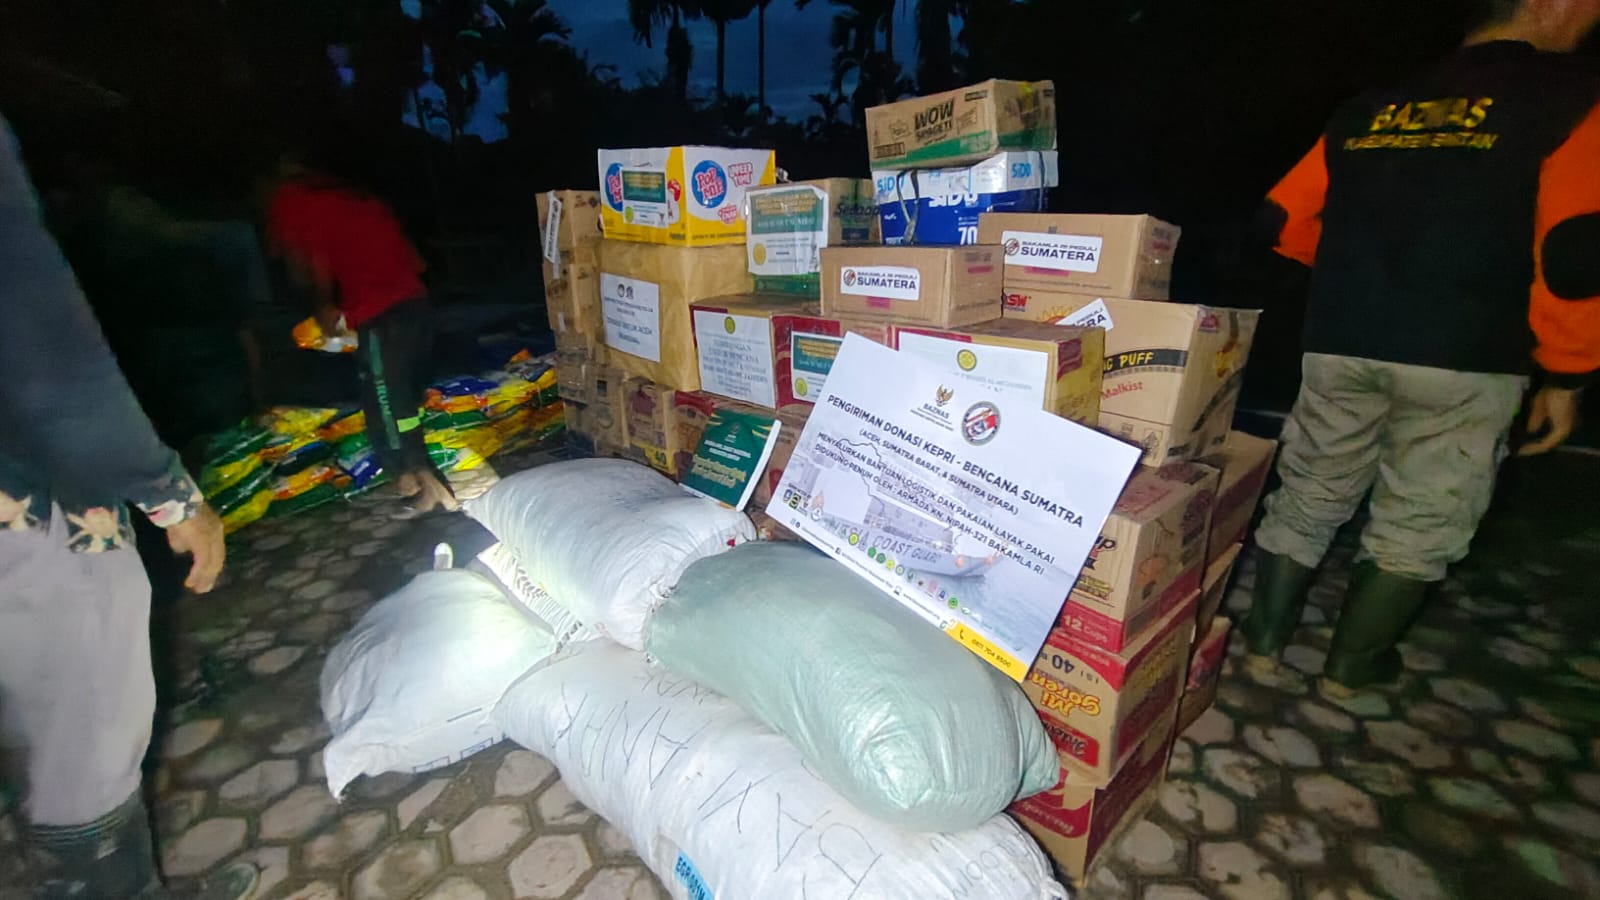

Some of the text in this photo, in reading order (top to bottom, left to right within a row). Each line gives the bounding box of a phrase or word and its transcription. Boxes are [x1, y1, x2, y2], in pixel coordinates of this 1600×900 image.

[914, 96, 955, 128] WOW
[696, 167, 716, 191] POP
[703, 180, 724, 201] MIE
[1020, 246, 1096, 262] SUMATERA
[1022, 240, 1059, 249] BAKAMLA
[1069, 244, 1098, 252] PEDULI
[857, 276, 917, 290] SUMATERA
[1120, 352, 1154, 368] PUFF
[1101, 381, 1144, 400] Malkist
[923, 403, 950, 419] BAZNAS
[827, 394, 884, 428] PENGIRIMAN
[884, 422, 923, 448] DONASI
[922, 441, 956, 464] KEPRI
[962, 461, 1019, 496] BENCANA
[1020, 490, 1084, 528] SUMATRA
[882, 440, 915, 462] SUMATRA
[948, 474, 986, 498] SUMATRA
[987, 493, 1019, 516] UTARA)
[818, 432, 1055, 564] MENYALURKAN BANTUAN LOGISTIK DAN PAKAIAN LAYAK PAKAI
[815, 444, 849, 466] DIDUKUNG
[848, 462, 874, 480] PENUH
[872, 476, 894, 490] OLEH
[896, 490, 930, 512] ARMADA
[946, 516, 988, 543] NIPAH-321
[988, 538, 1032, 569] BAKAMLA
[1033, 564, 1044, 576] RI
[872, 536, 912, 556] COAST
[1064, 614, 1082, 630] 12
[1052, 654, 1075, 674] 40
[1043, 692, 1070, 717] Mi
